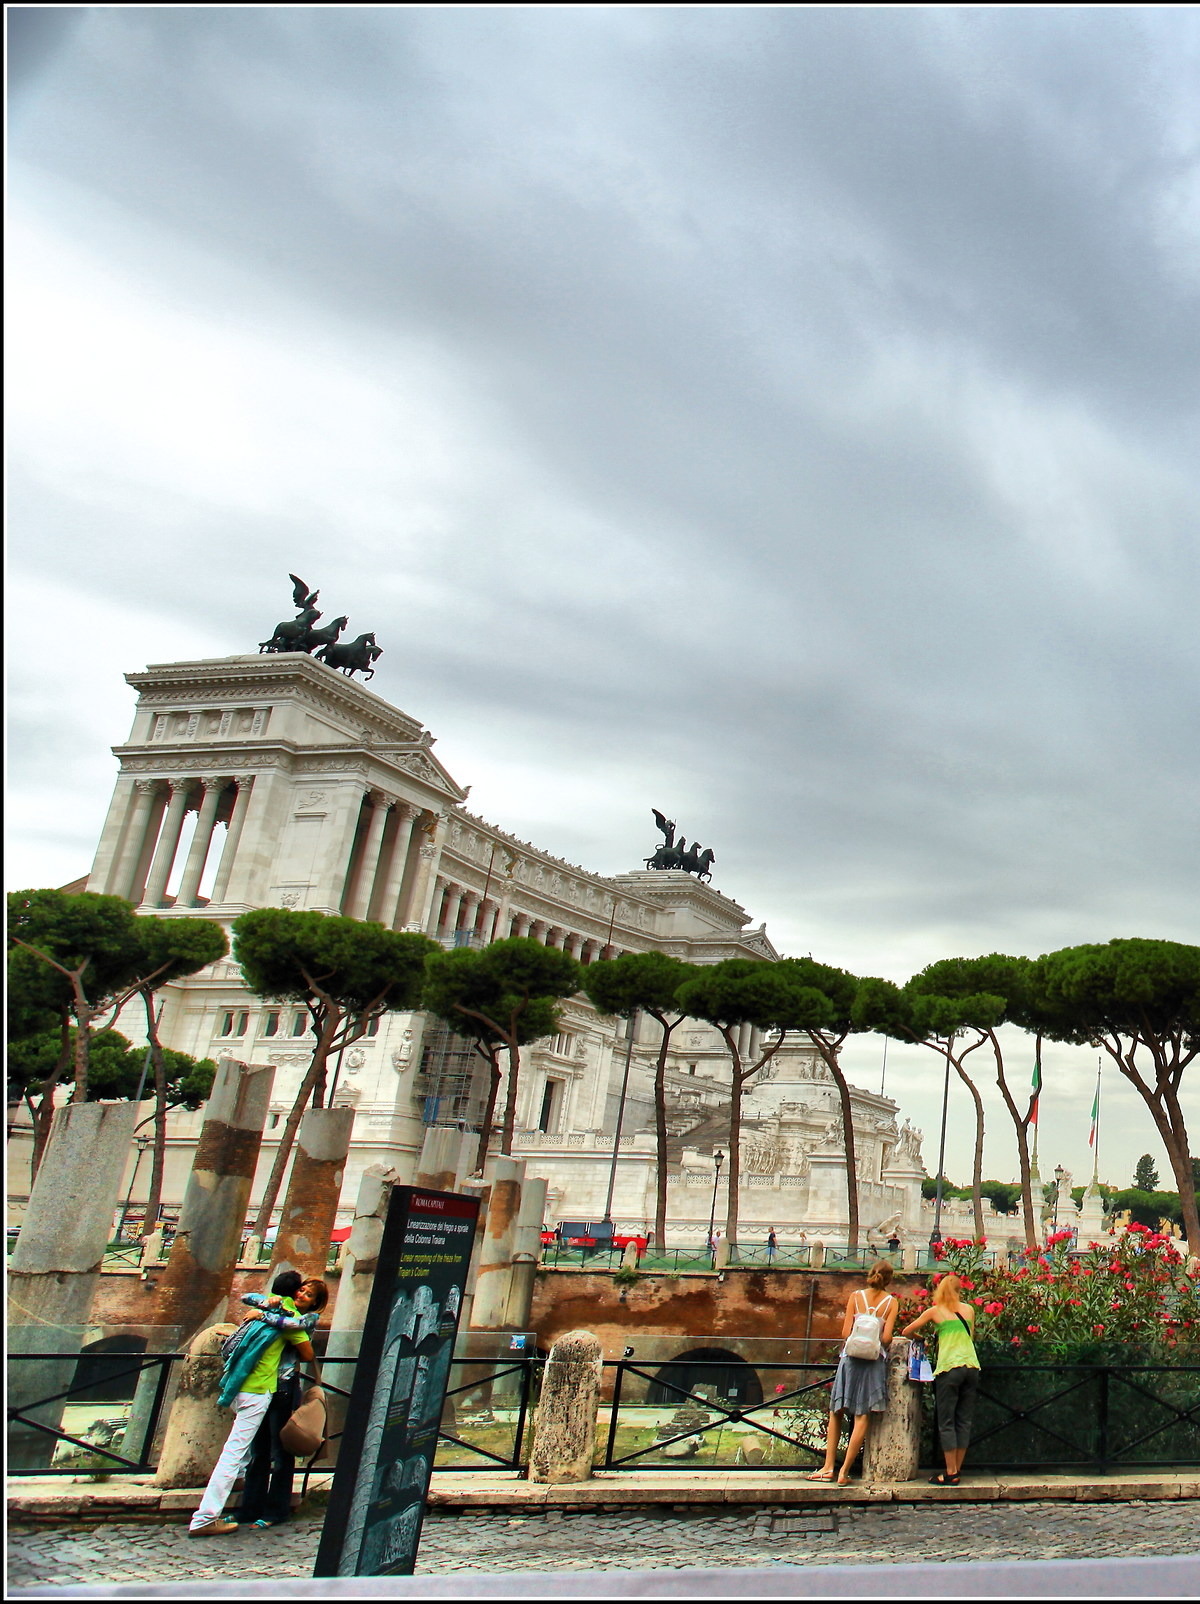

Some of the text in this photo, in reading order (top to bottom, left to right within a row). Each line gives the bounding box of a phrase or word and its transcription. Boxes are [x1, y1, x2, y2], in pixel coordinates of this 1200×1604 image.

[407, 1219, 437, 1231] Linearizzazione
[404, 1233, 446, 1245] della Colonna Traiana
[400, 1253, 414, 1263] Linear
[414, 1266, 430, 1277] Column
